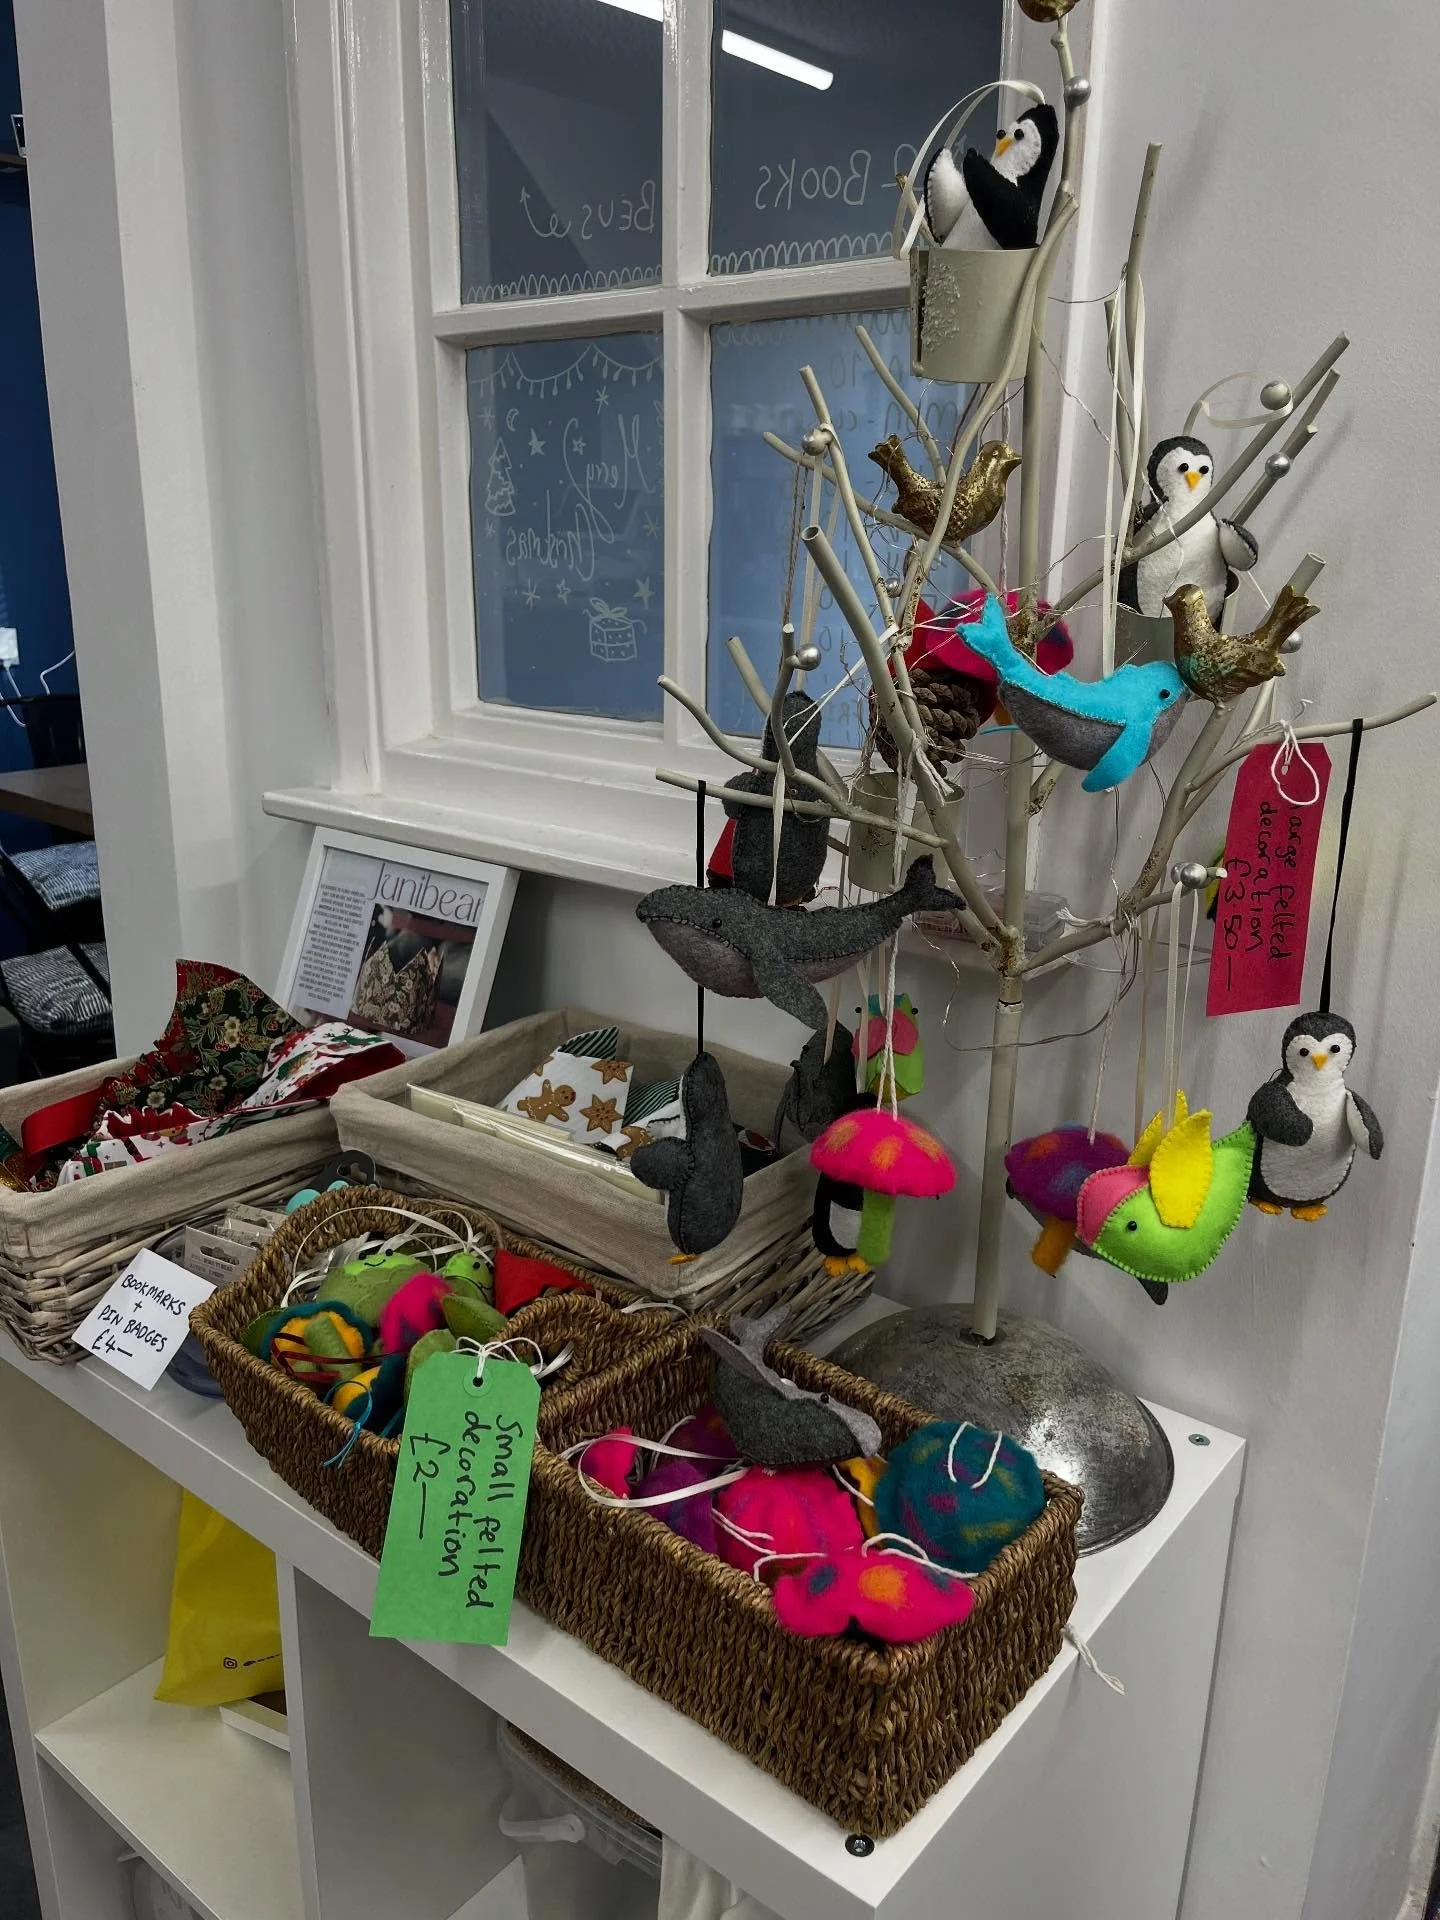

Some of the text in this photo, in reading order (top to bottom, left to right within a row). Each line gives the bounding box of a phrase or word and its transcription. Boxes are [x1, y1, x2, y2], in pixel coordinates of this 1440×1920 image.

[1245, 801, 1279, 952] decoration
[1269, 803, 1305, 960] arge felted
[98, 1304, 168, 1352] PIN BADGES
[121, 1274, 186, 1316] BOOKMARKS
[438, 1410, 492, 1577] decoration
[465, 1414, 523, 1608] Small felted
